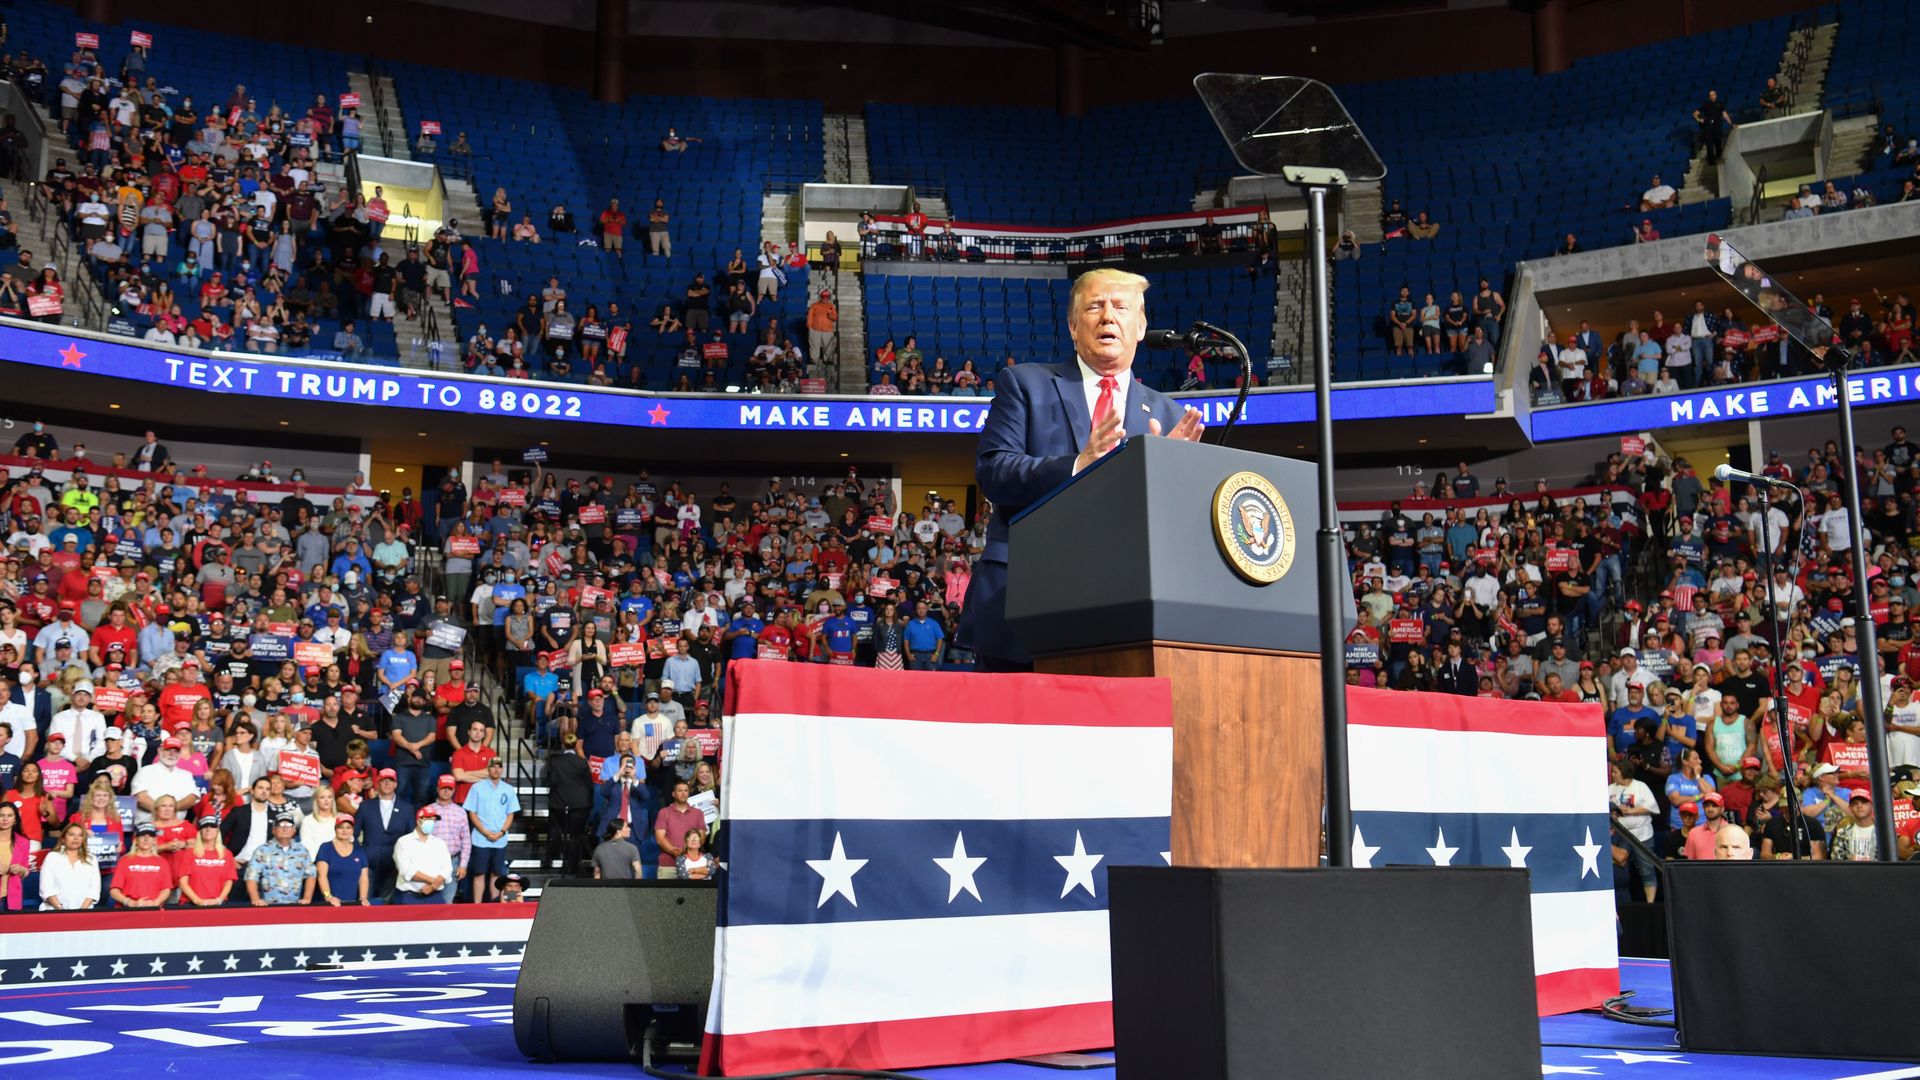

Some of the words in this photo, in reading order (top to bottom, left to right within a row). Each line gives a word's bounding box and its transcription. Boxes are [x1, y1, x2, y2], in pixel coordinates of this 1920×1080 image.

[108, 324, 135, 332] AMERICA
[165, 358, 259, 390] TEXT
[276, 371, 401, 401] TRUMP
[417, 383, 462, 406] TO
[478, 389, 582, 417] 88022
[1193, 402, 1248, 422] IN!
[1671, 391, 1768, 421] MAKE
[740, 405, 830, 427] MAKE
[1397, 465, 1423, 476] 113
[791, 476, 816, 487] 114
[1221, 476, 1252, 513] PRESIDENT
[1275, 496, 1293, 542] UNITED
[1233, 549, 1254, 573] SEAL
[1266, 553, 1290, 578] STATES
[432, 630, 461, 642] AMERICA
[96, 695, 129, 704] AMERI
[281, 761, 318, 775] AMERICA
[300, 772, 319, 782] AGAIN
[86, 845, 116, 854] RICA
